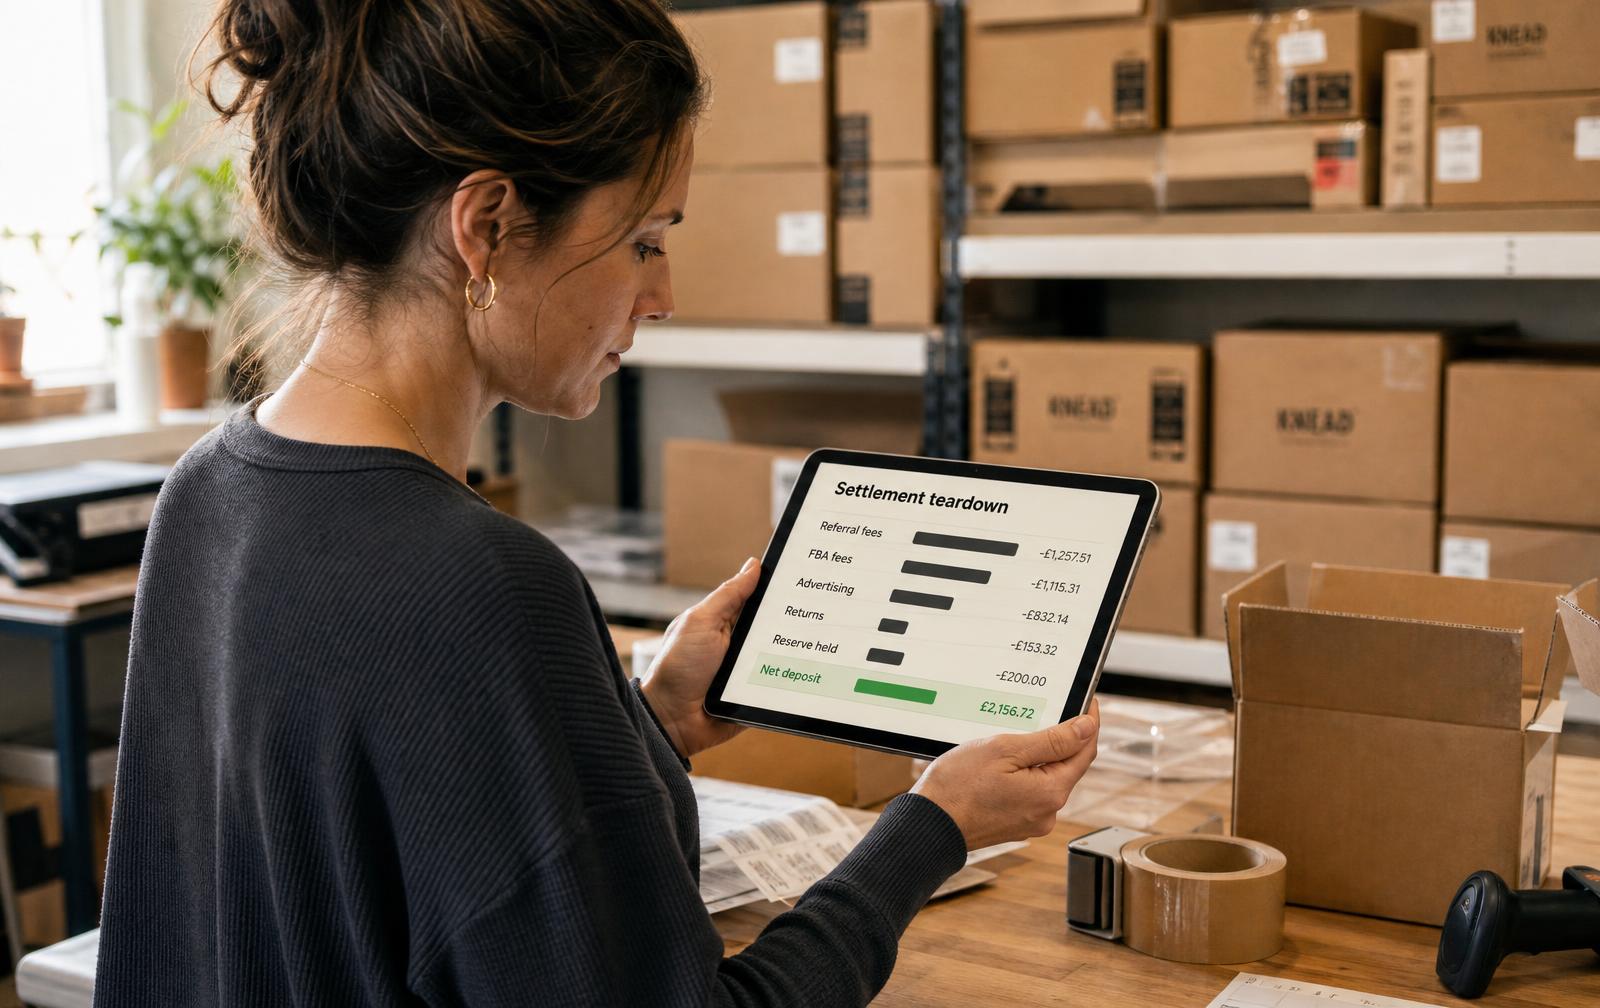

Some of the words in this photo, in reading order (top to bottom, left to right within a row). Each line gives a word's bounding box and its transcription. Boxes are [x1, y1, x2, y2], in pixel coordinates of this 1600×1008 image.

[834, 481, 926, 505] Settlement
[928, 492, 1009, 515] teardown
[819, 520, 861, 536] Referral
[861, 525, 883, 538] fees
[807, 548, 829, 561] FBA
[830, 551, 854, 565] fees
[1039, 549, 1092, 564] -£1,257.51
[795, 577, 855, 597] Advertising
[1031, 579, 1081, 595] -£1,115.31
[784, 605, 825, 621] Returns
[1021, 609, 1069, 625] -£832.14
[772, 634, 812, 650] Reserve
[814, 640, 839, 655] held
[1010, 640, 1058, 656] -£153.32
[759, 663, 780, 678] Net
[781, 667, 822, 685] deposit
[995, 670, 1047, 687] -£200.00
[979, 700, 1035, 720] £2,156.72
